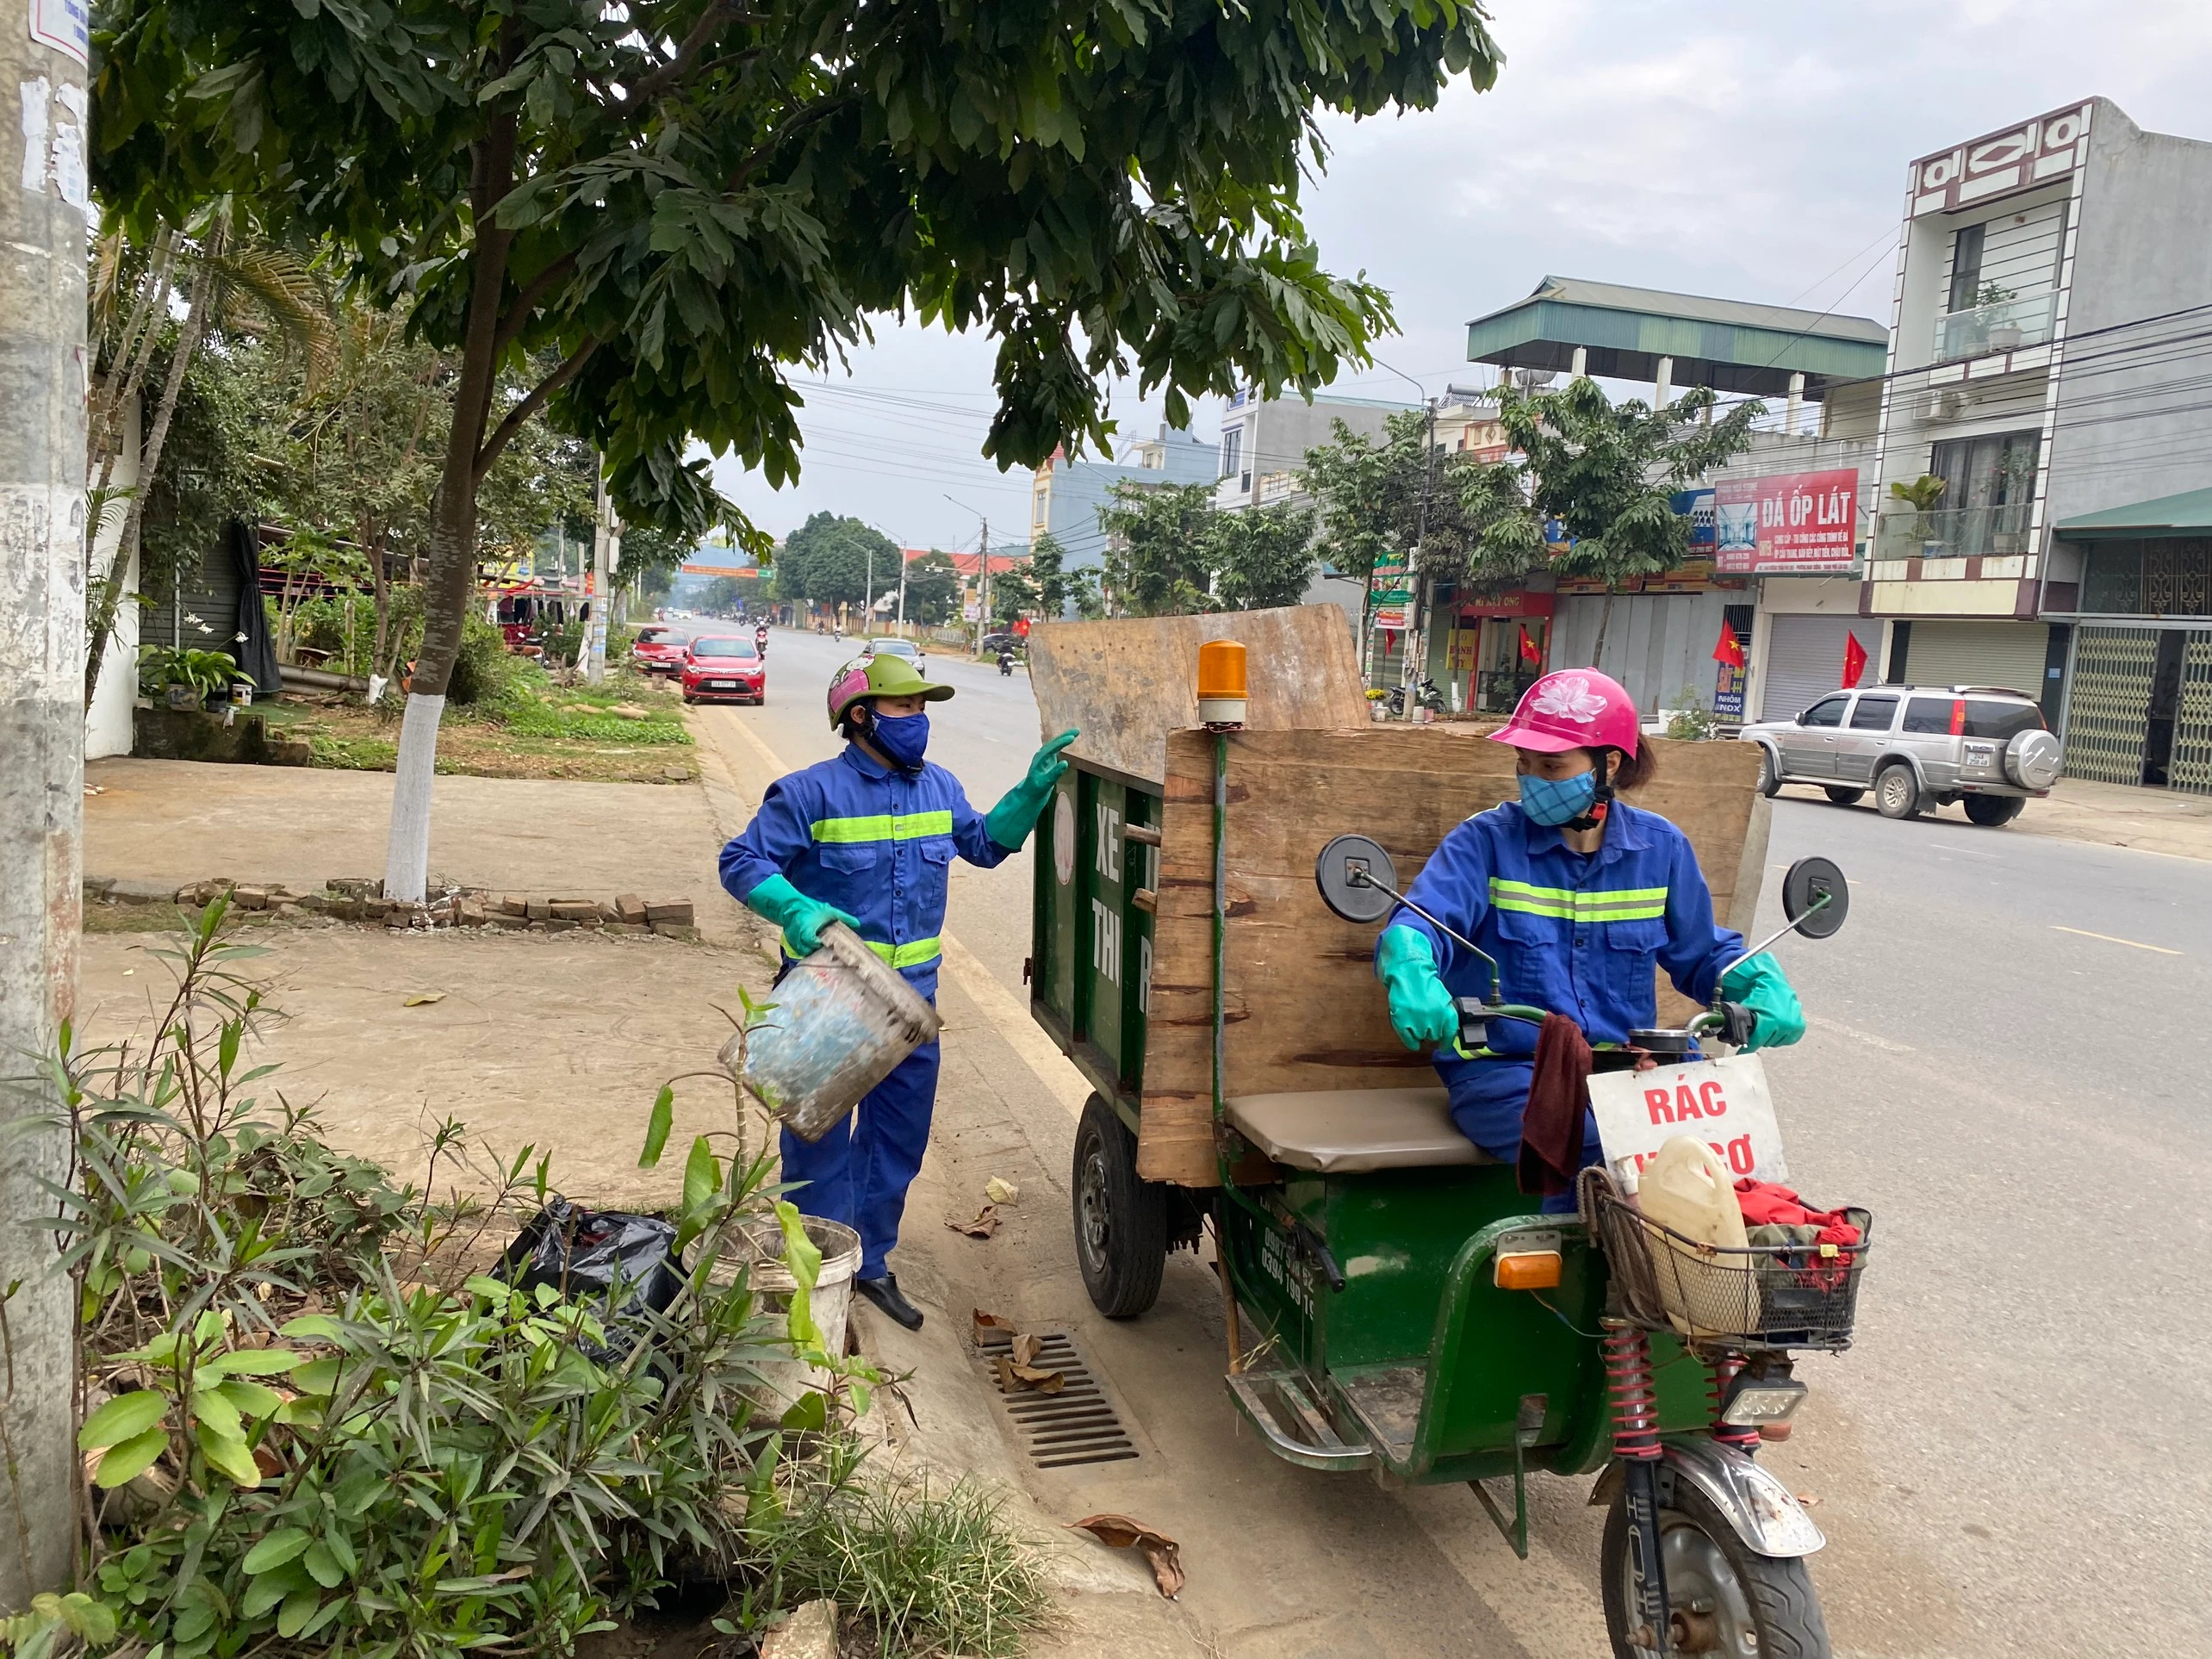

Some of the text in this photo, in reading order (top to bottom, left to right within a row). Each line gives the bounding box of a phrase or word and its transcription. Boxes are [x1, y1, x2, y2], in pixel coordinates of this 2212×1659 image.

[1762, 484, 1851, 527] ĐÁ ỐP LÁT
[1450, 646, 1473, 655] BNH
[1718, 694, 1742, 703] NHÔM
[1096, 803, 1120, 883] XE
[1643, 1074, 1727, 1125] RÁC
[1261, 1247, 1283, 1285] 0394
[1285, 1273, 1301, 1306] 199
